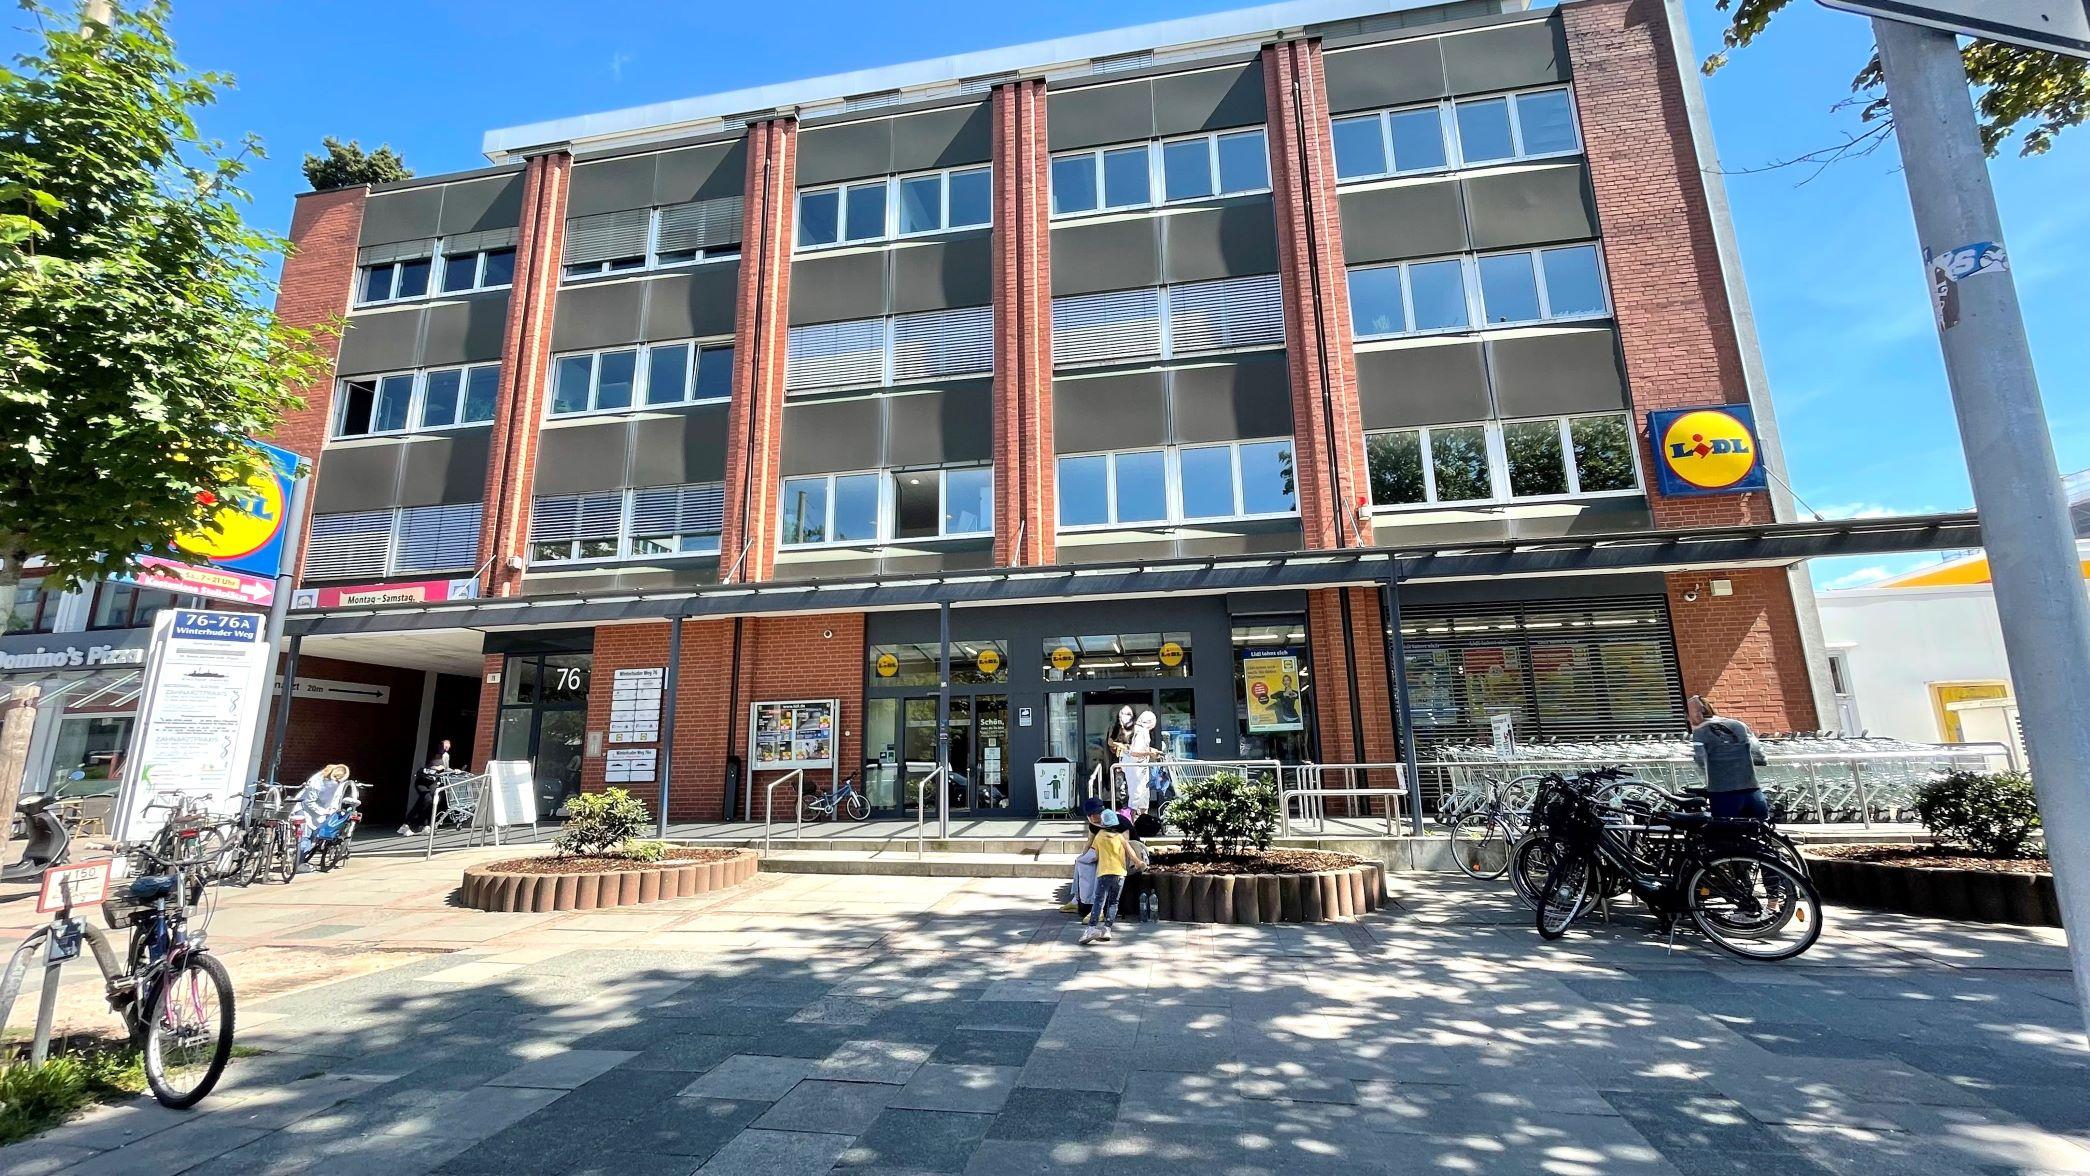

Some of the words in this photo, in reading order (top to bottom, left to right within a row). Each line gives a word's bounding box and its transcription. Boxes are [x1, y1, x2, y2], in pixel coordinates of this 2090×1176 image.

[176, 626, 233, 637] Winterhuder
[234, 630, 254, 640] Weg
[87, 644, 144, 665] Pizza
[556, 667, 581, 691] 76
[306, 684, 324, 693] 20m
[980, 718, 1005, 726] Schön,
